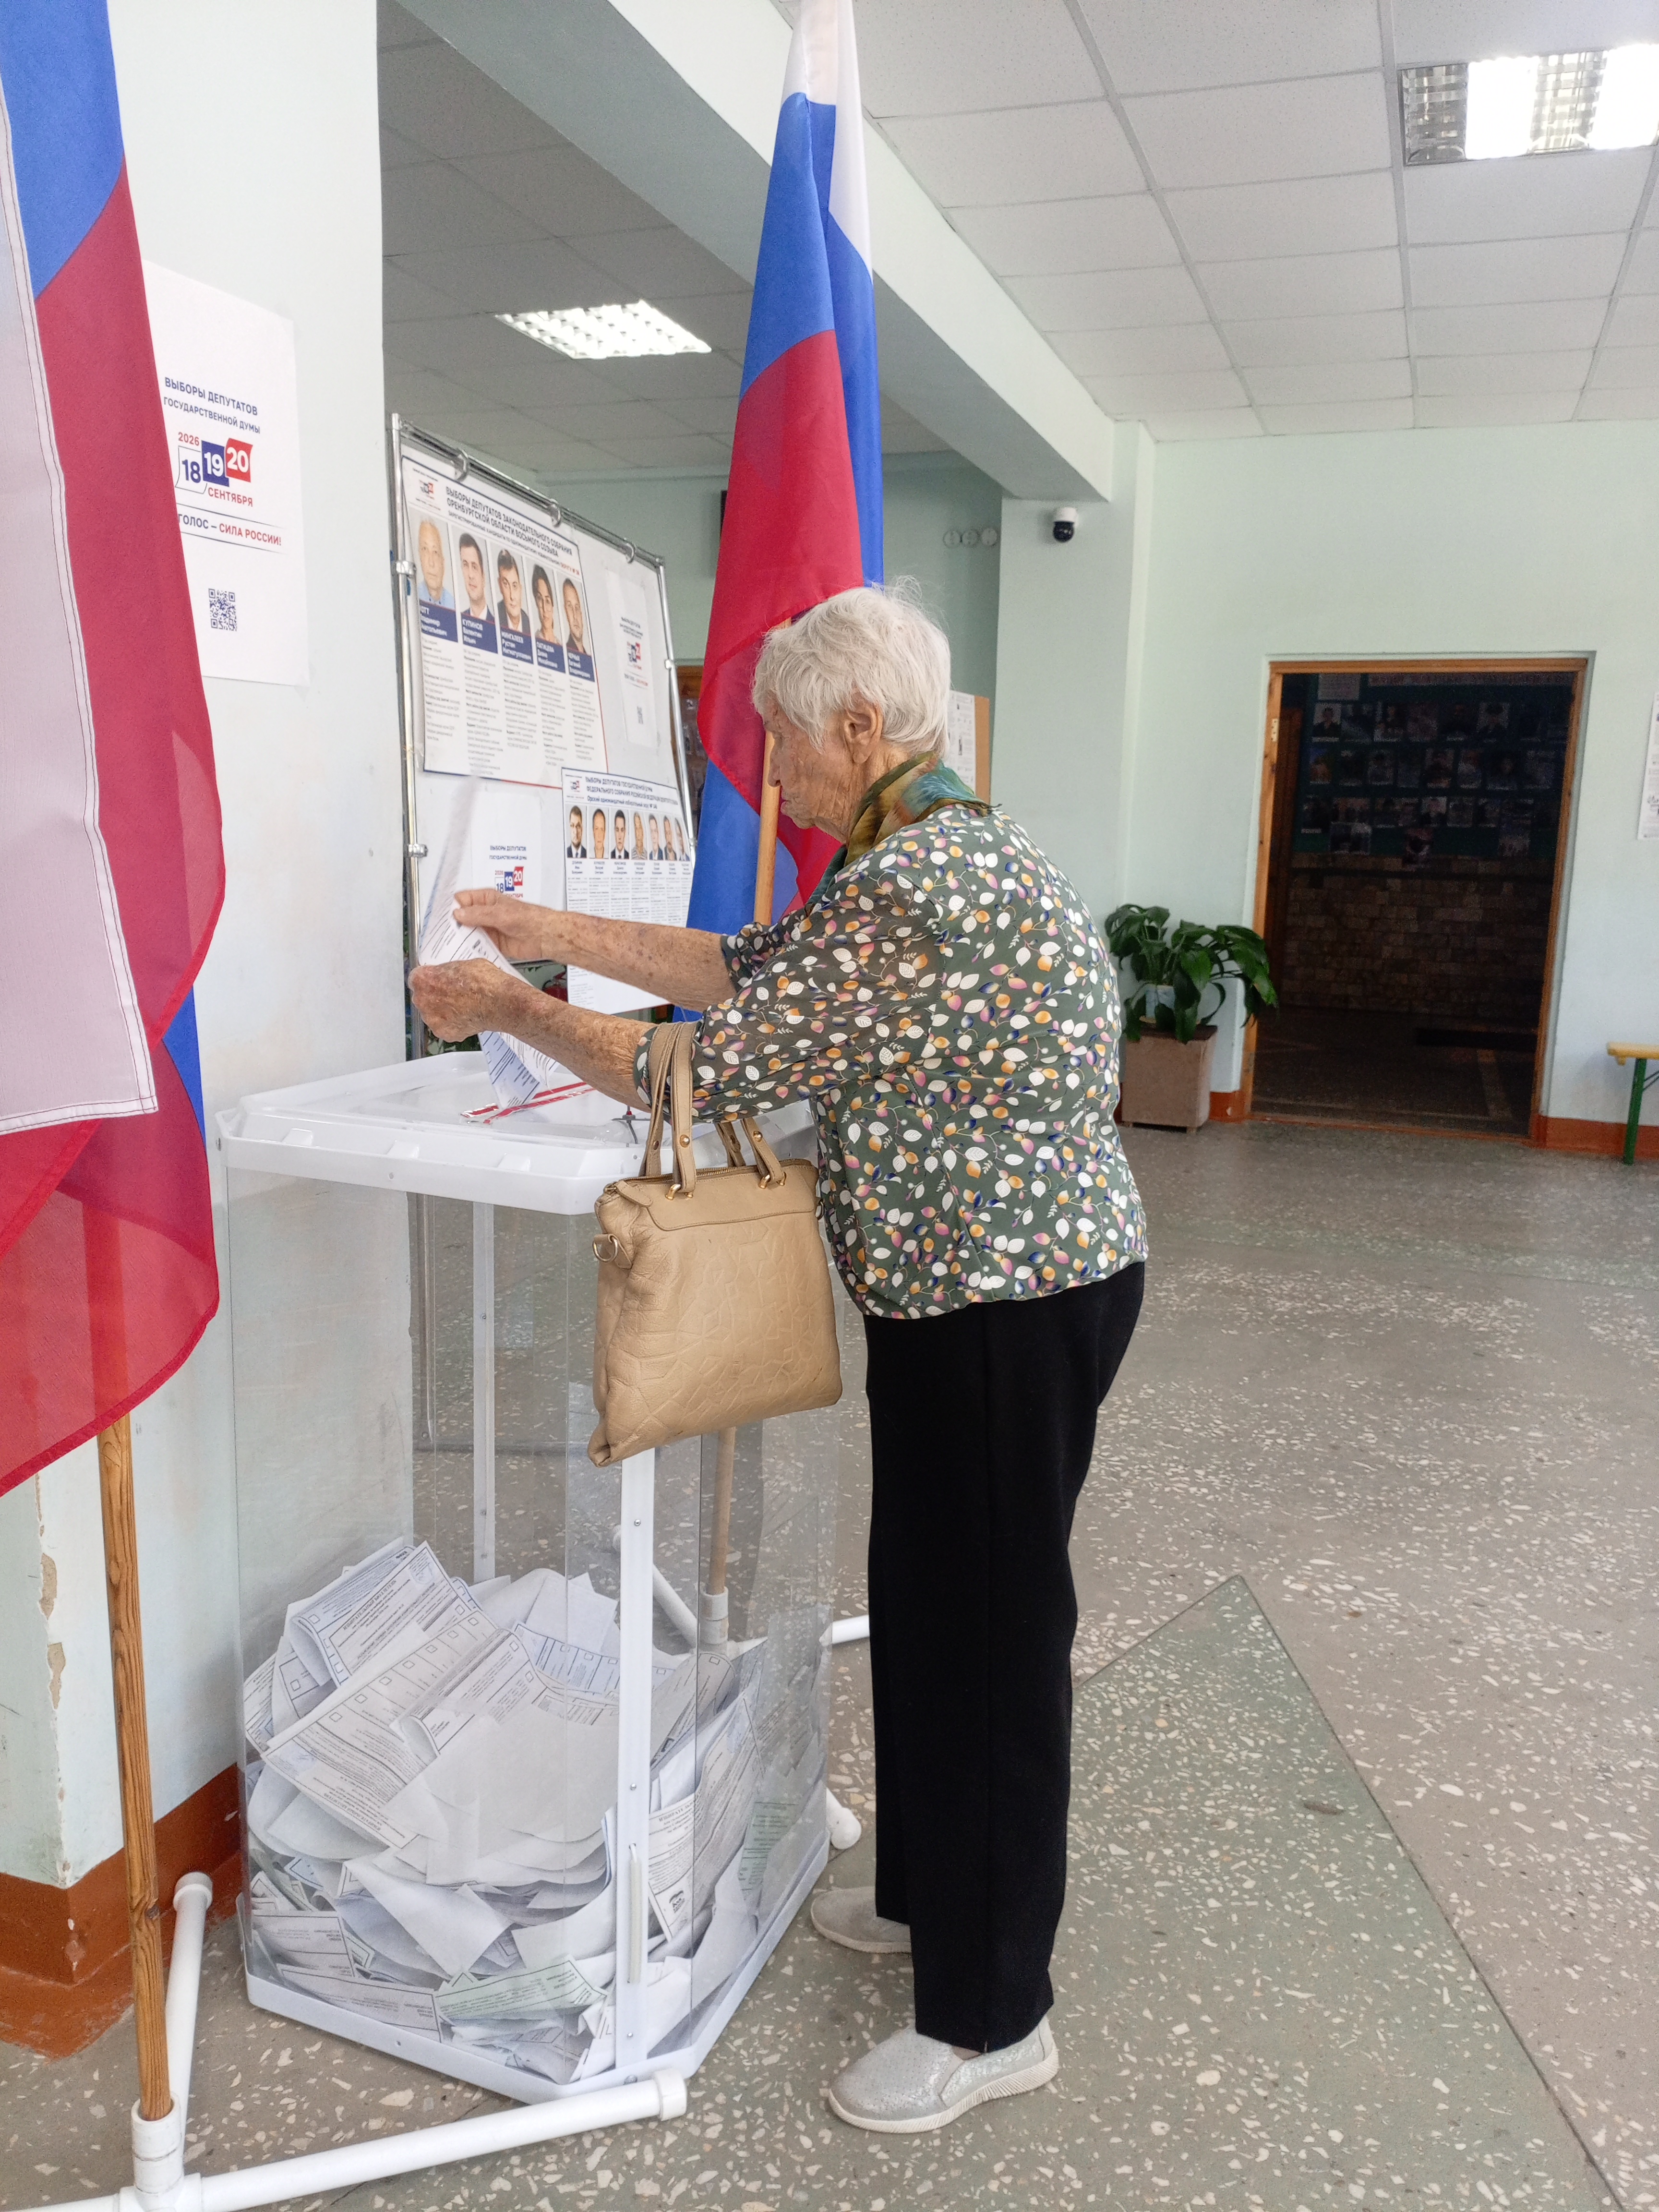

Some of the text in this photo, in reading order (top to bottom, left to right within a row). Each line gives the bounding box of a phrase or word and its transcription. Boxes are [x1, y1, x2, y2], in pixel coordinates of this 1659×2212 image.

[165, 377, 258, 416] ВЫБОРЫ ДЕПУТАТОВ
[164, 397, 260, 434] ГОСУДАРСТВЕННОЙ ДУМЫ
[178, 432, 200, 446] 2026
[182, 447, 249, 483] 18 19 20
[208, 487, 253, 506] СЕНТЯБРЯ
[446, 486, 470, 505] ВЫБОРЫ
[471, 498, 502, 520] ДЕПУТАТОВ
[178, 514, 208, 529] ГОЛОС
[219, 523, 242, 538] СИЛА
[245, 529, 282, 546] РОССИИ!
[447, 497, 490, 525] ОРЕНБУРГСКОЙ
[491, 518, 515, 536] ОБЛАСТИ
[496, 870, 522, 893] 18 19 20
